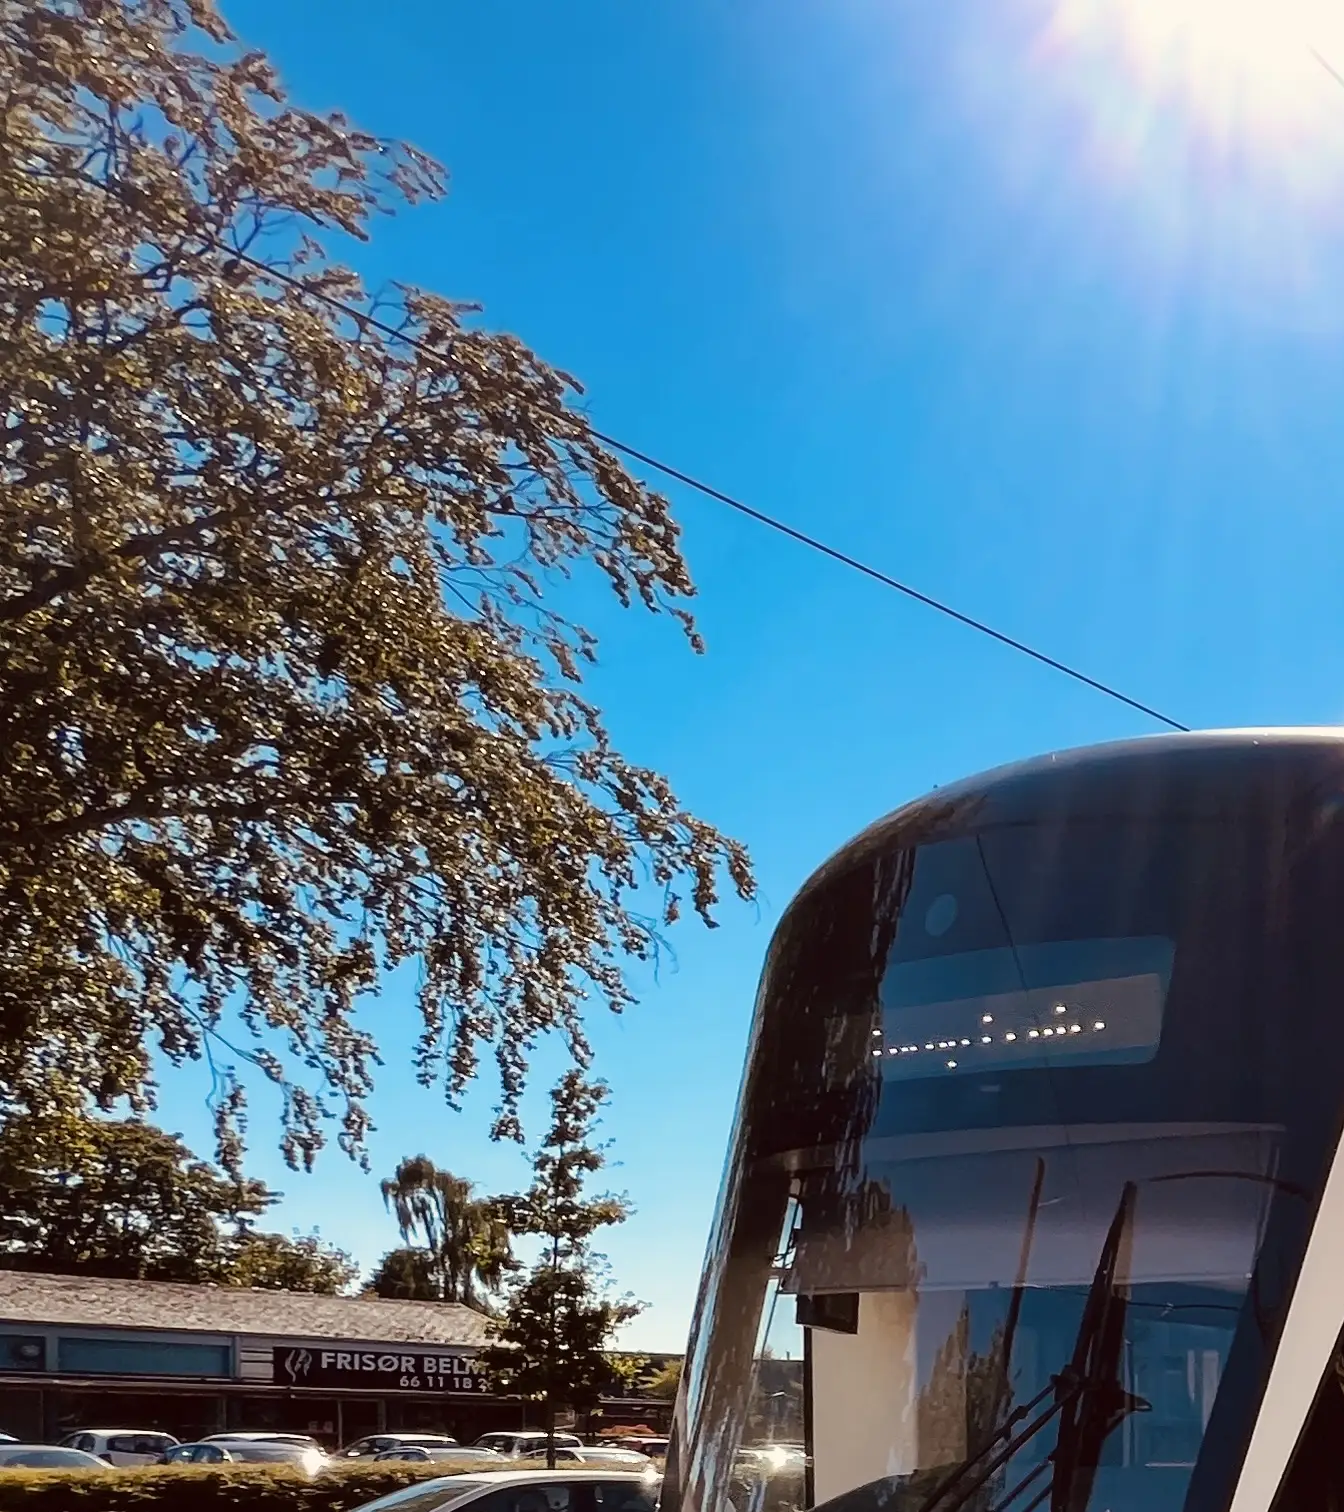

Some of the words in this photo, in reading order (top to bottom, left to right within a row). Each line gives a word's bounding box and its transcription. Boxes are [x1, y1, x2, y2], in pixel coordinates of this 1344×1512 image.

[321, 1351, 416, 1373] FRISØR
[423, 1356, 487, 1375] BELM
[400, 1375, 420, 1388] 66
[427, 1376, 444, 1388] 11
[453, 1377, 472, 1389] 18
